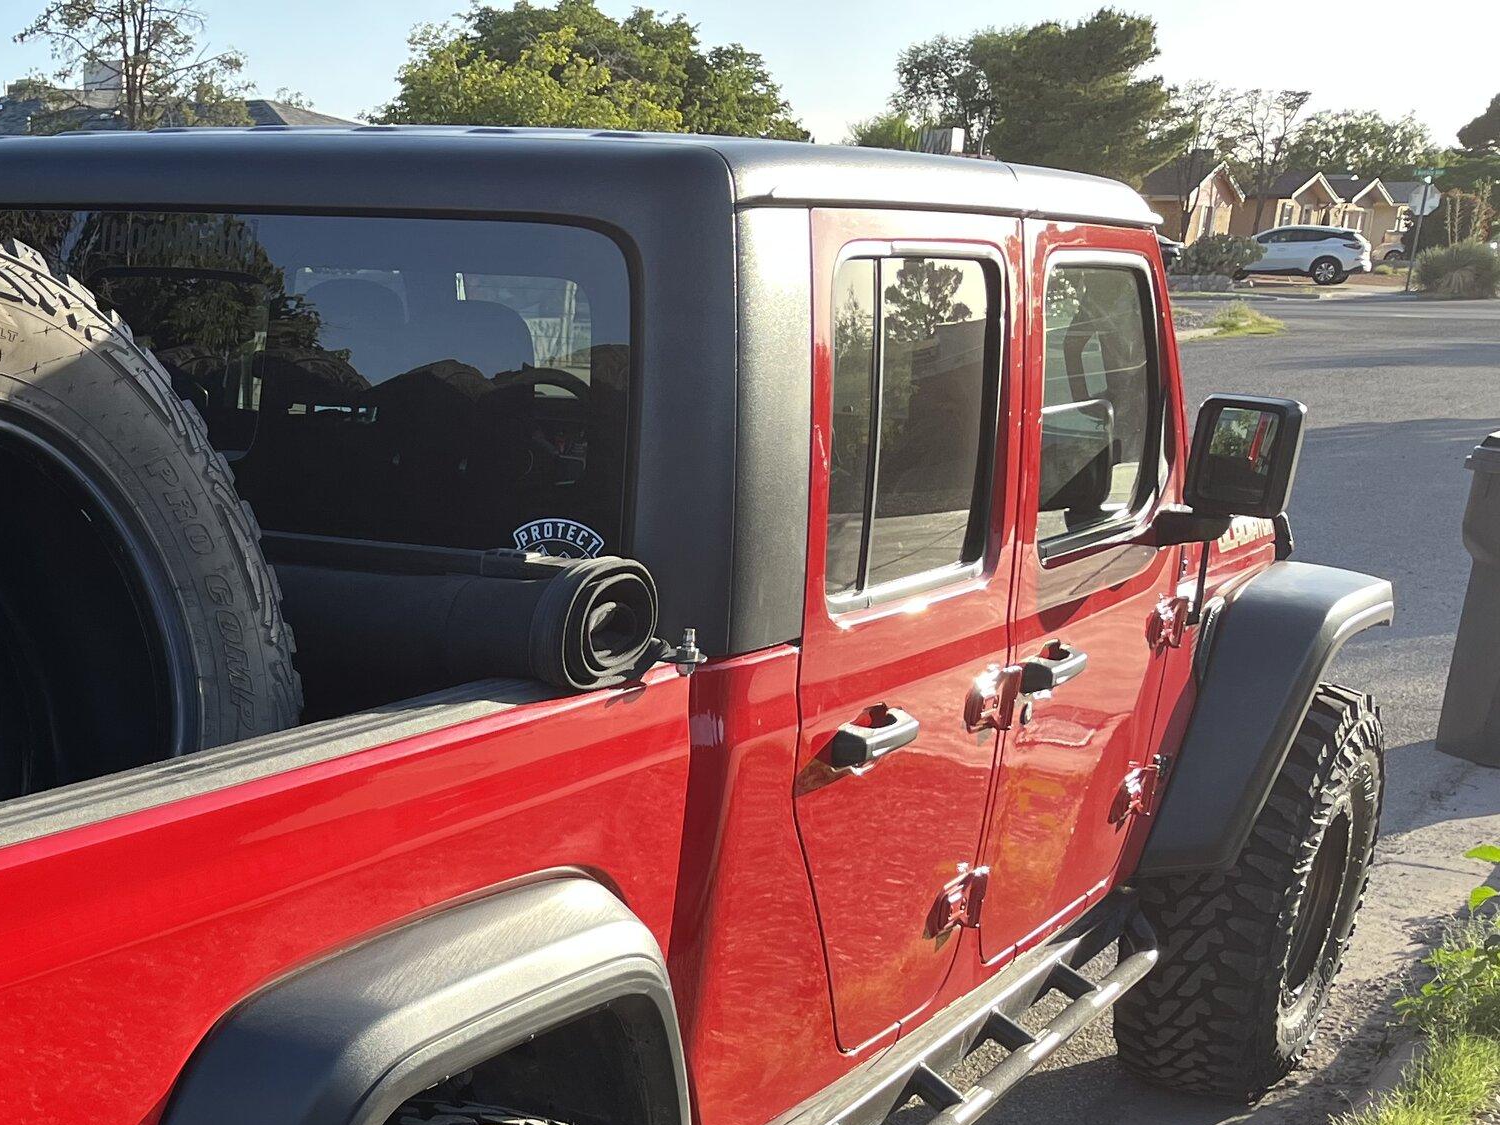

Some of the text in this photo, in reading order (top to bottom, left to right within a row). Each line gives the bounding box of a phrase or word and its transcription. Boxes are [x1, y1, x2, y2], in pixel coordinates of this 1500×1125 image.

[145, 455, 215, 556] PRO
[204, 573, 257, 732] COMP
[517, 521, 600, 554] PROTECT
